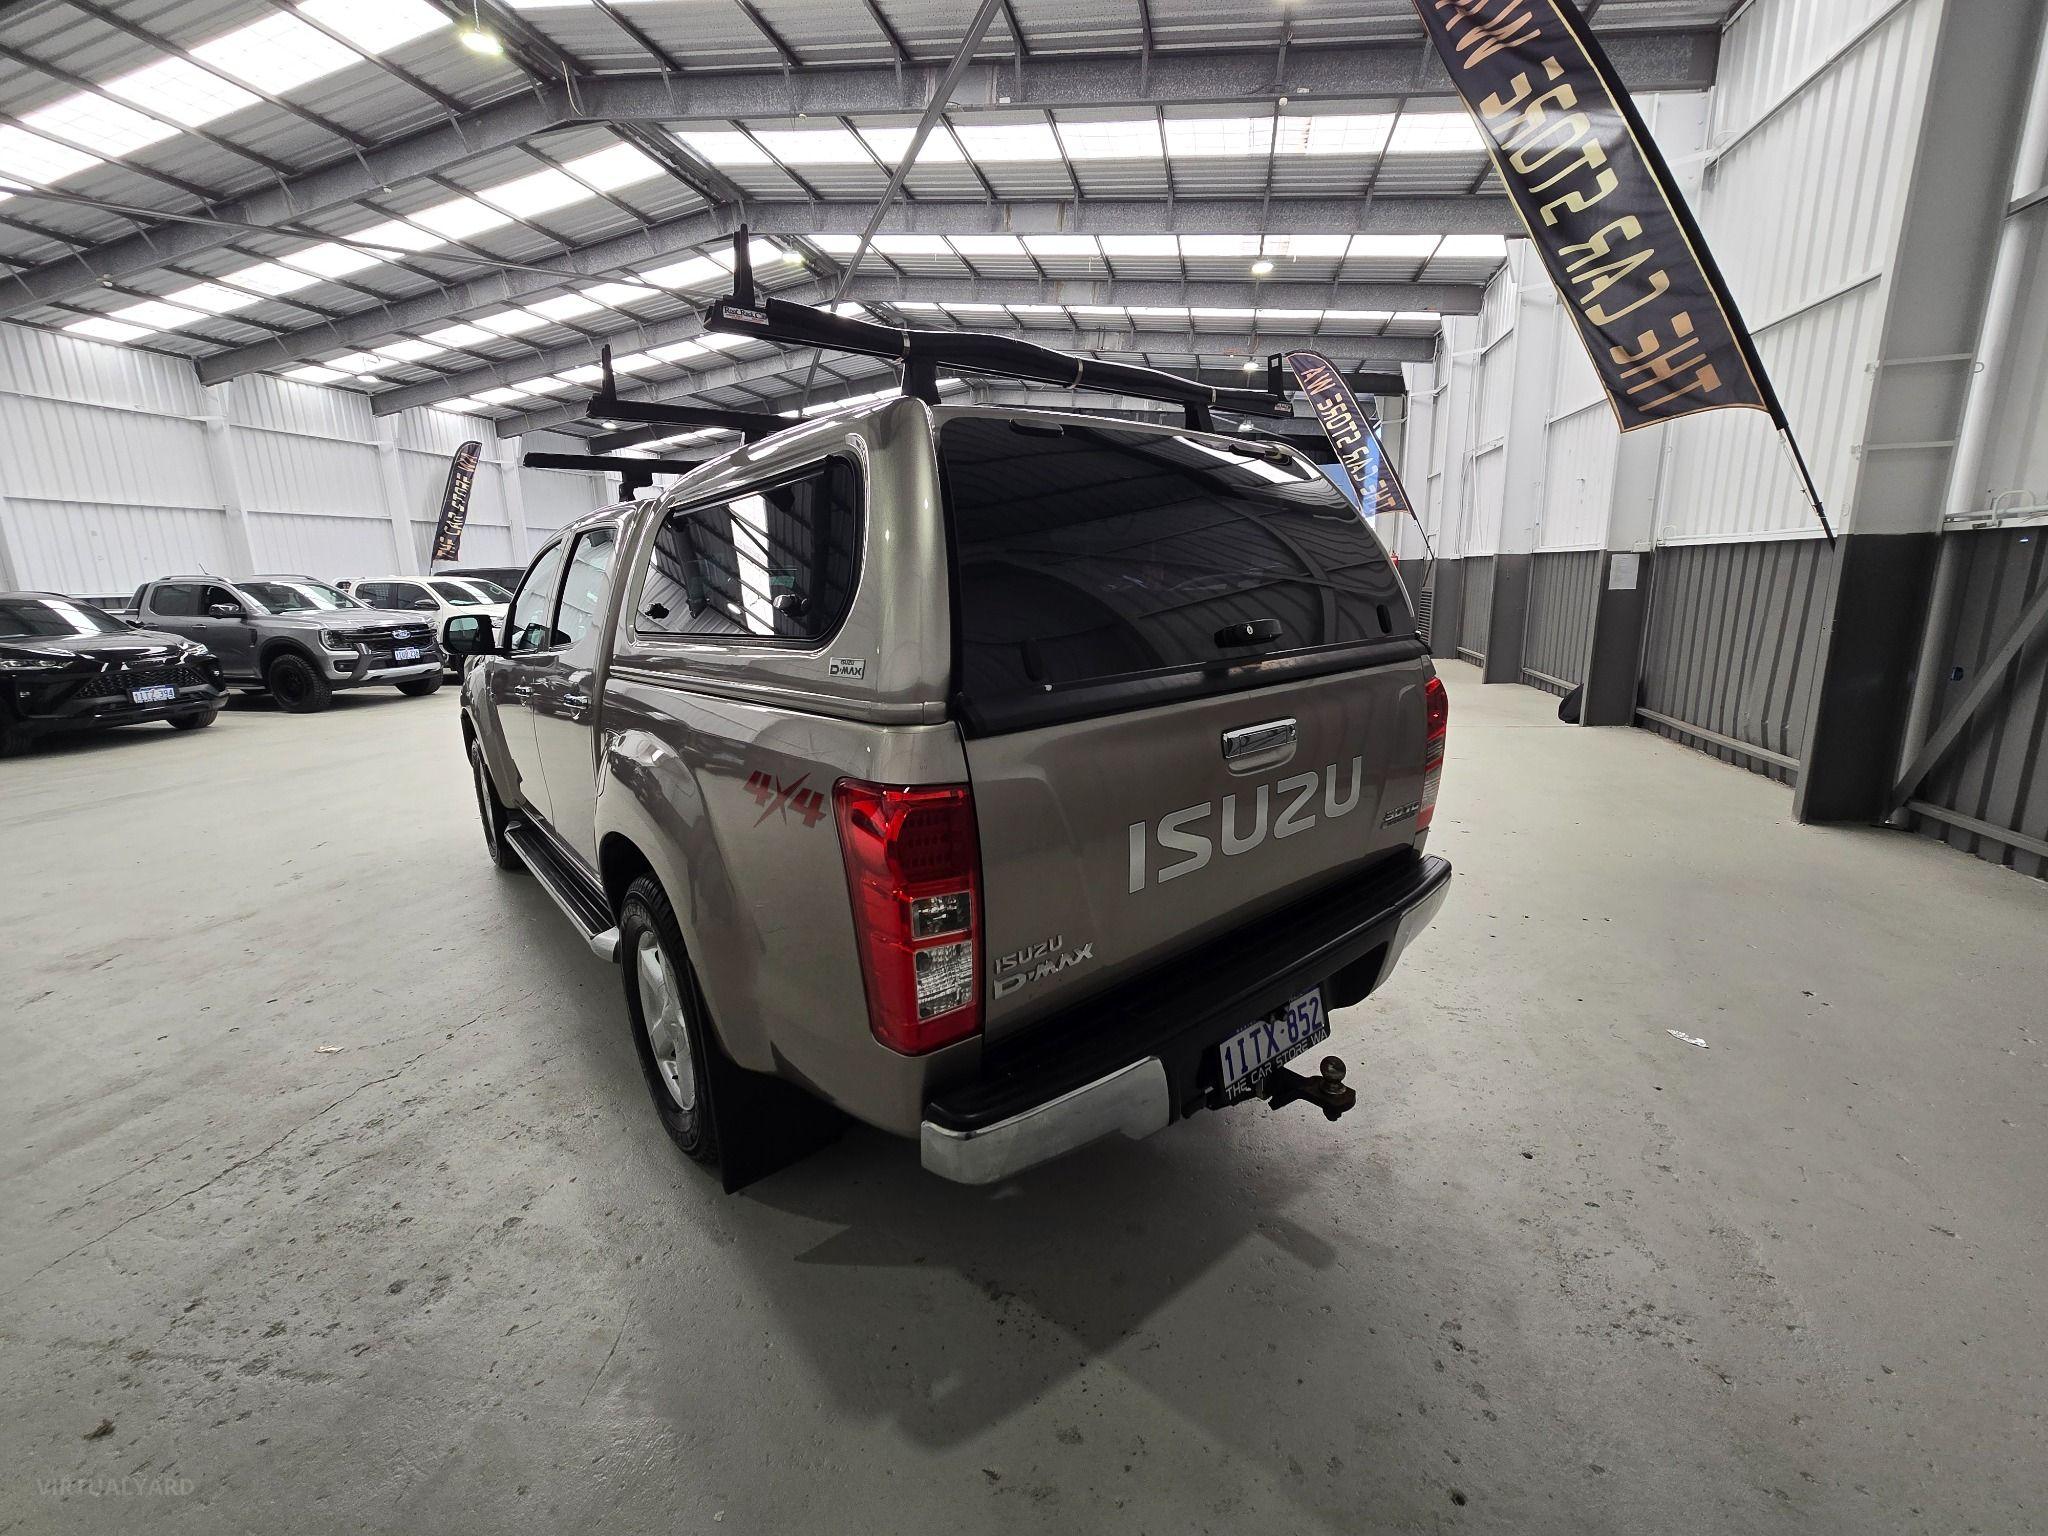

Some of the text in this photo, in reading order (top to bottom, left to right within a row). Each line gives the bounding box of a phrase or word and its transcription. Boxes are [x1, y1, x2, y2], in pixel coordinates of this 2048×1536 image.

[452, 473, 471, 512] STORE
[444, 511, 463, 536] CAR
[1128, 755, 1363, 894] ISUZU
[995, 934, 1062, 975] ISUZU
[1226, 1028, 1328, 1101] THE CAR STORE WA
